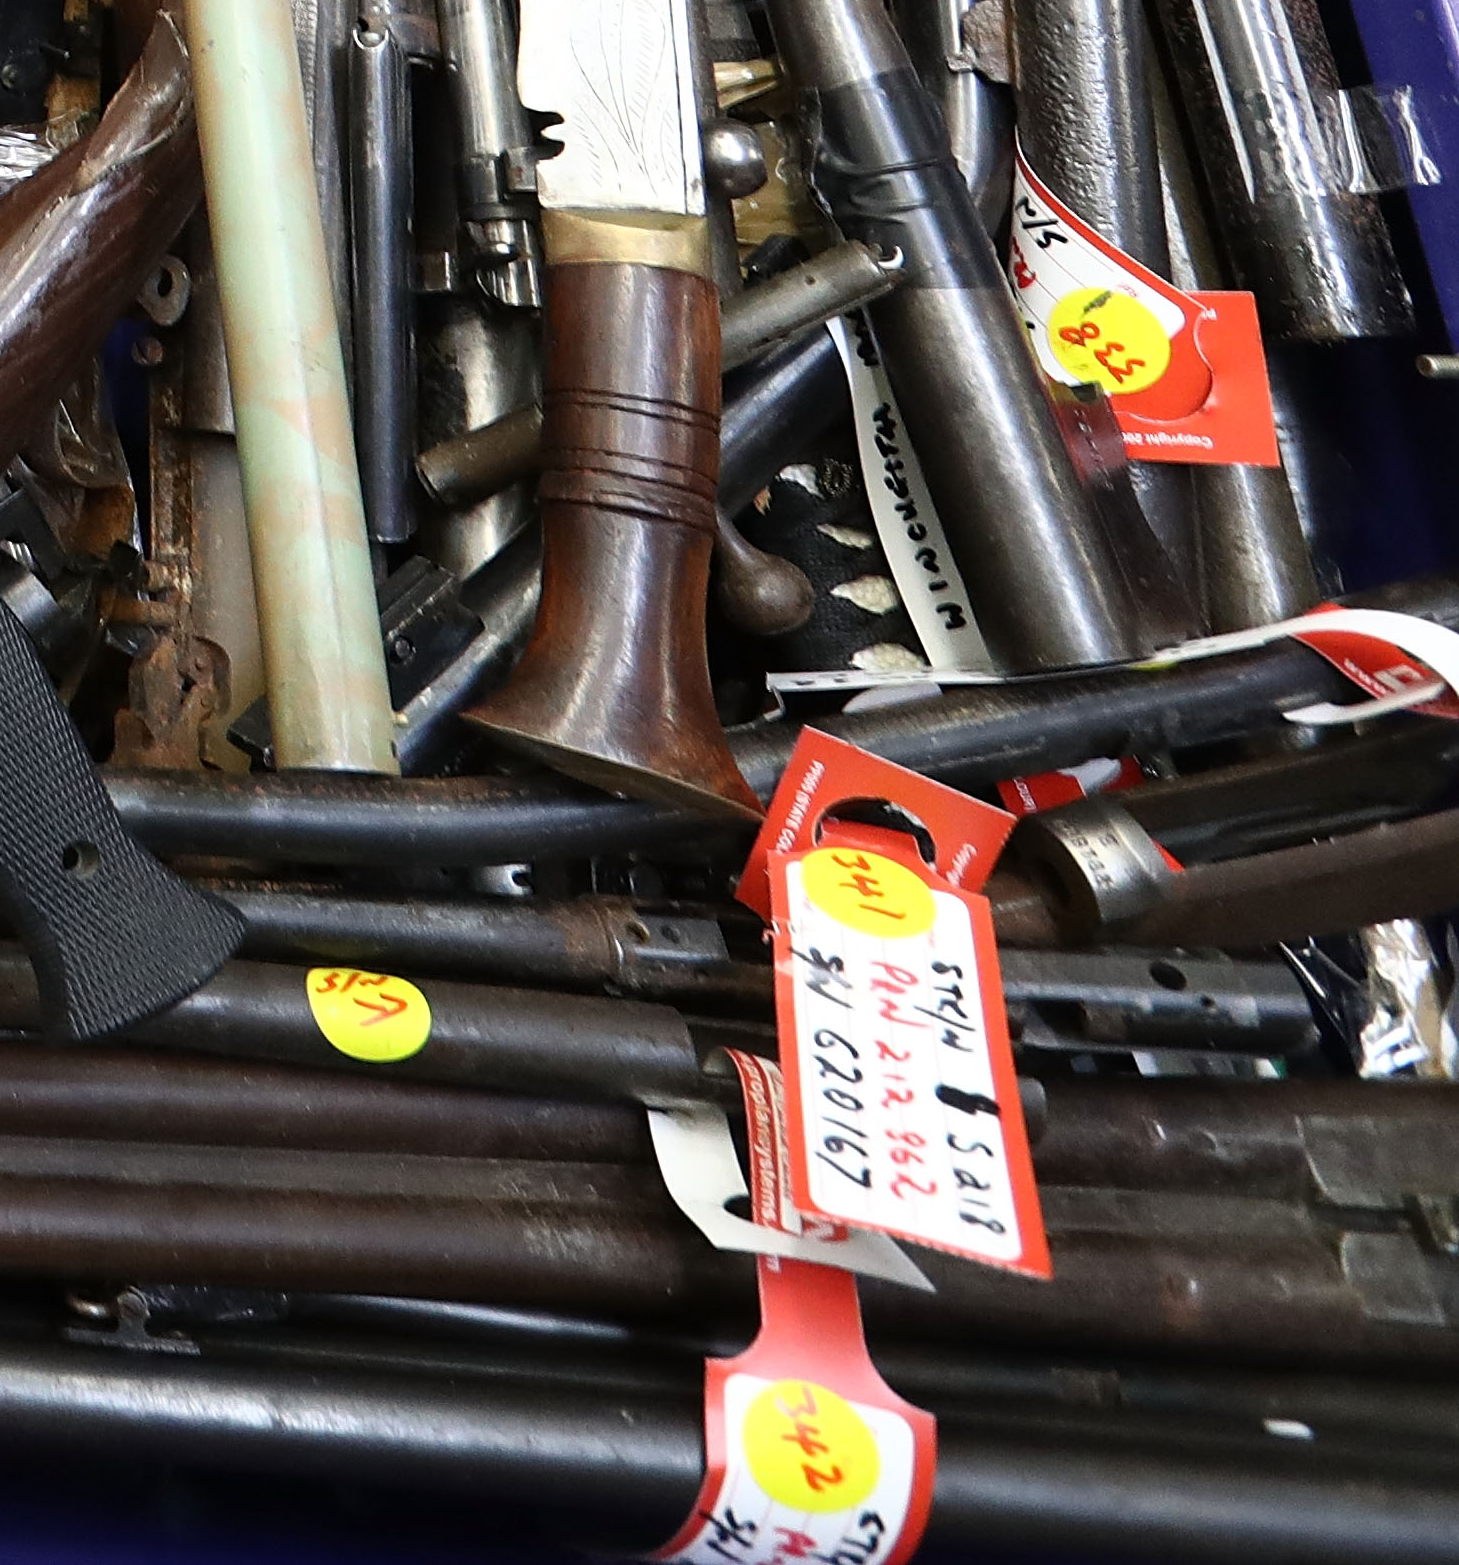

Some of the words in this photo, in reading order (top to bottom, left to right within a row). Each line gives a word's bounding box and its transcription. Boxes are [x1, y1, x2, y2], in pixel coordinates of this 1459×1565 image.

[1142, 426, 1213, 449] Copyright
[831, 854, 907, 921] 341
[814, 1027, 871, 1190] 620167
[873, 1039, 915, 1111] 212
[775, 1385, 846, 1494] 342
